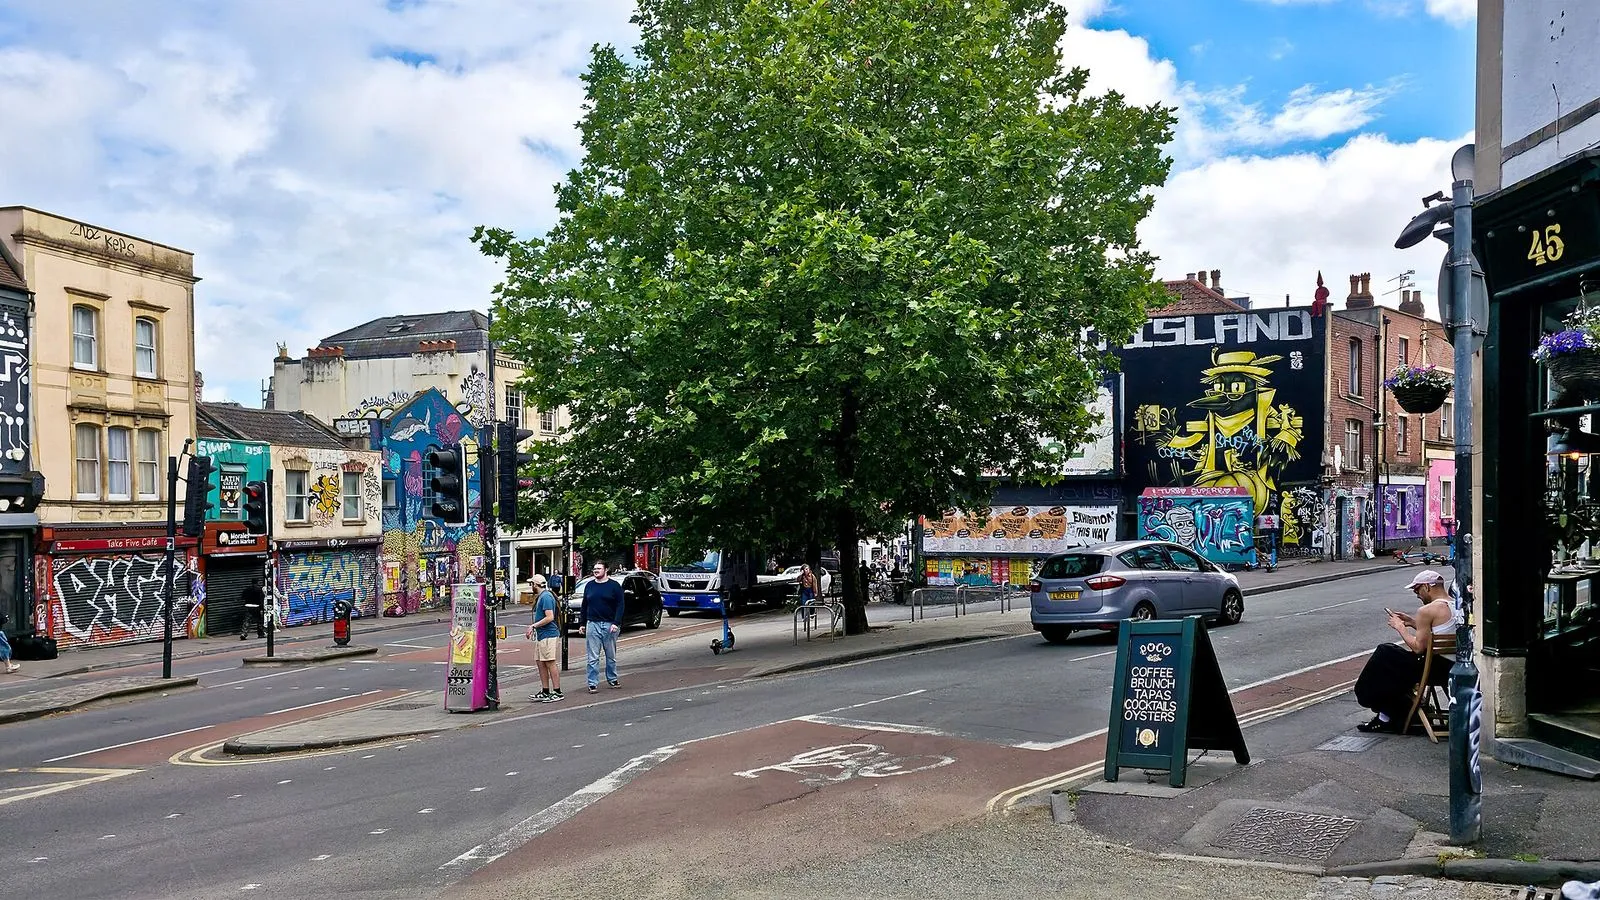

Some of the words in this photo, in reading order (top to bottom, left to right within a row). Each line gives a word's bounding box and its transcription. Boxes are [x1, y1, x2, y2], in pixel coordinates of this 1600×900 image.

[1528, 224, 1564, 266] 45
[1123, 310, 1313, 349] ISLAND
[1072, 511, 1114, 525] EXHIBITION
[1076, 527, 1090, 538] THIS
[1092, 527, 1110, 542] WAY
[107, 540, 123, 548] Take
[125, 539, 139, 547] Five
[455, 606, 477, 614] CHINA
[450, 669, 472, 677] SPACE
[1131, 666, 1174, 678] COFFEE
[1130, 678, 1175, 689] BRUNCH
[449, 687, 466, 695] PRSC
[1134, 689, 1171, 700] TAPAS
[1124, 699, 1177, 712] COCKTAILS
[1124, 710, 1175, 722] OYSTERS
